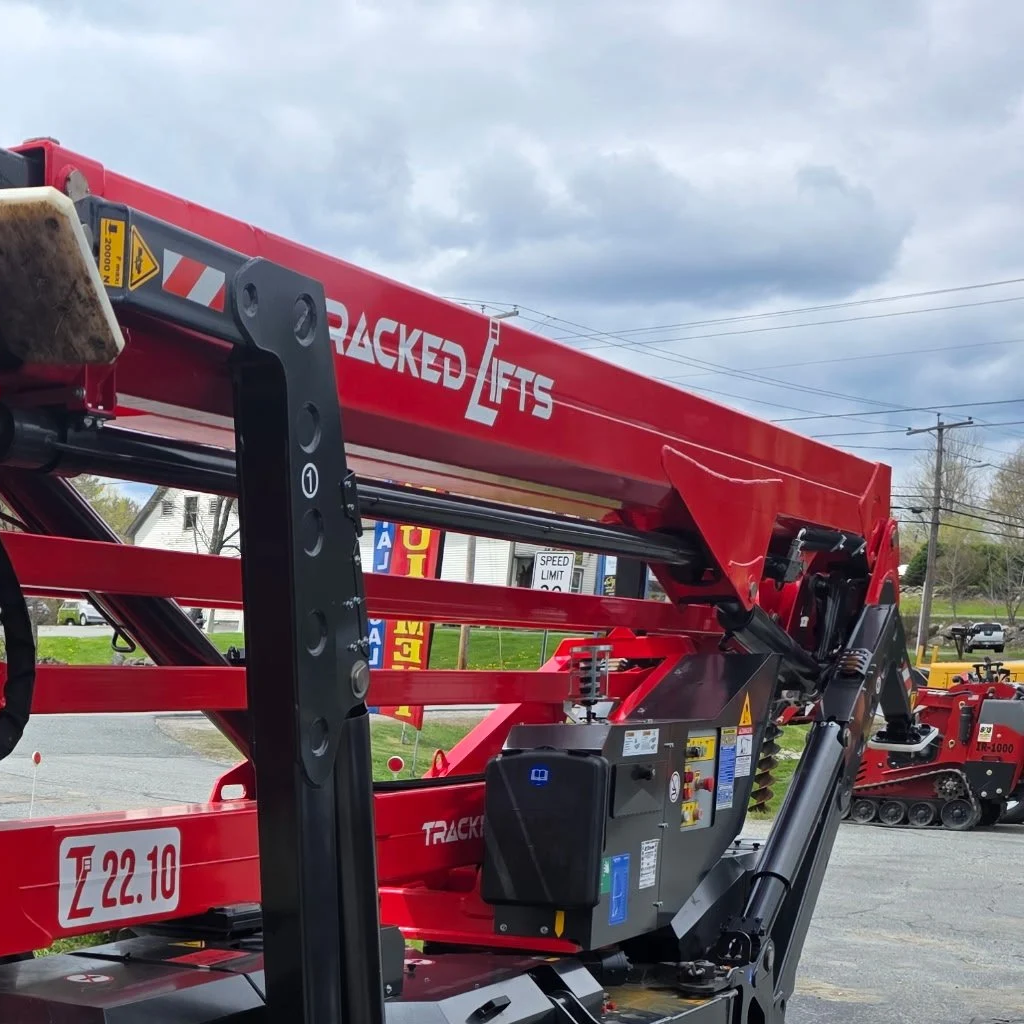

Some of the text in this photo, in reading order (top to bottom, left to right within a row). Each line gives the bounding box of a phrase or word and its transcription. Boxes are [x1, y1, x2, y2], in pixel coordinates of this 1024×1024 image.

[325, 298, 555, 427] RACKED LIFTS
[540, 555, 570, 567] SPEED
[541, 570, 565, 581] LIMIT
[101, 843, 176, 908] 22.10
